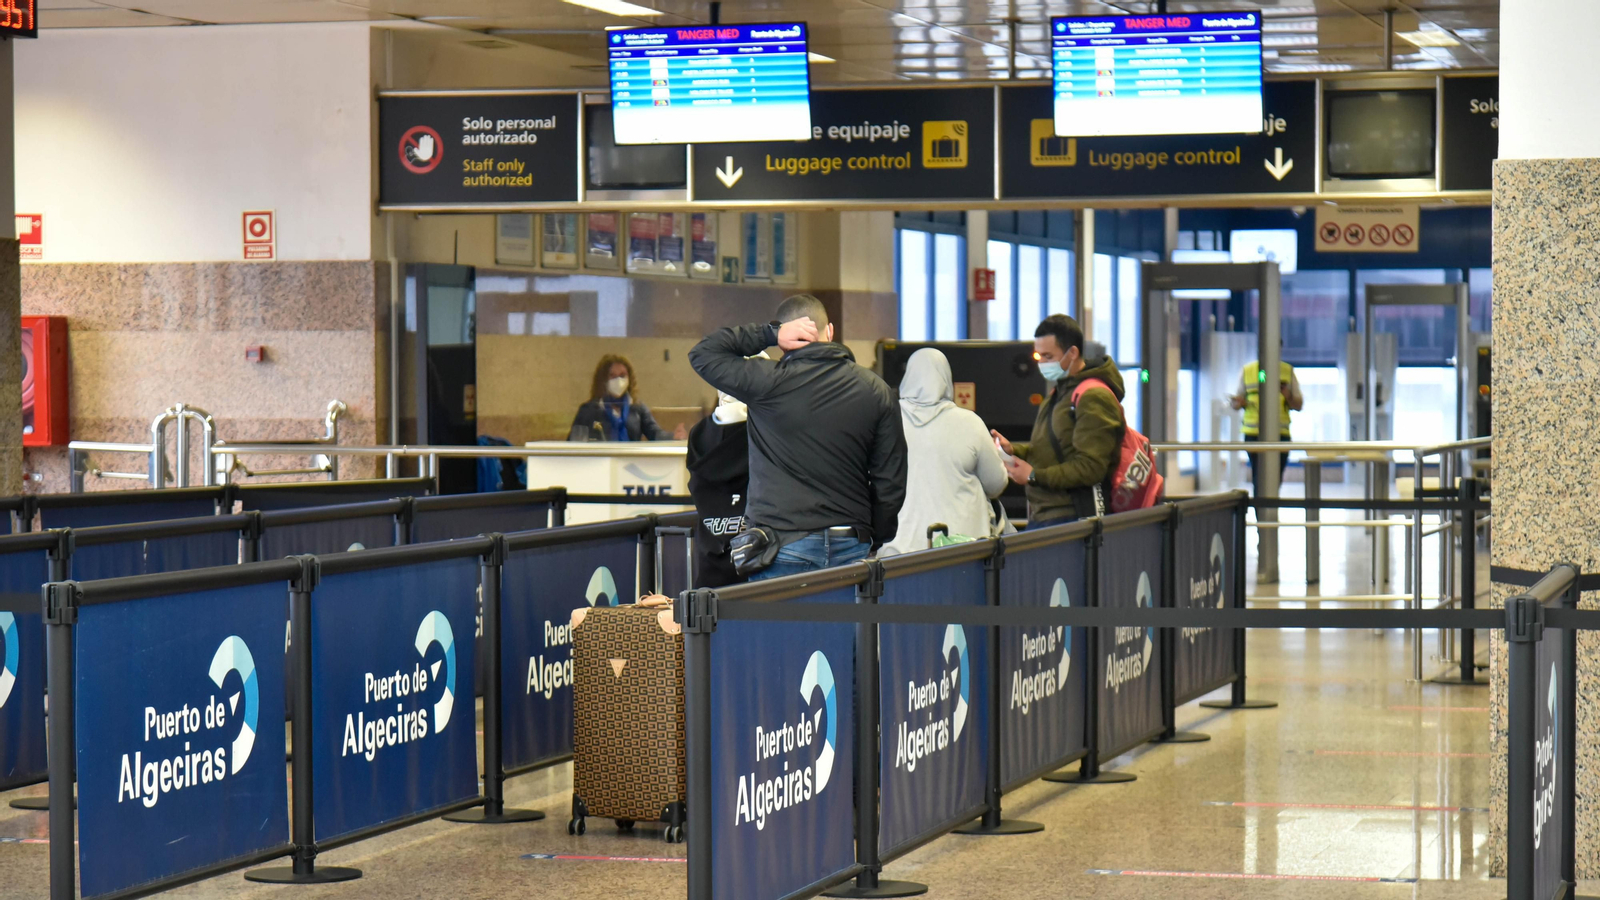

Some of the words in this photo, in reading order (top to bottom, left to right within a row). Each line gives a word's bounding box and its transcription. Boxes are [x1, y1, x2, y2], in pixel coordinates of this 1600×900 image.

[676, 29, 715, 40] TANGER
[717, 28, 740, 39] MED
[1124, 18, 1165, 29] TANGER
[1166, 17, 1191, 28] MED
[462, 116, 493, 131] Solo
[496, 115, 556, 133] personal
[462, 130, 537, 145] autorizado
[828, 120, 911, 143] equipaje
[463, 158, 494, 172] Staff
[497, 158, 525, 174] only
[463, 172, 533, 187] authorized
[765, 153, 842, 176] Luggage
[847, 151, 911, 170] control
[1089, 149, 1169, 171] Luggage
[1174, 146, 1241, 165] control
[1022, 632, 1046, 661] Puerto
[1047, 625, 1056, 653] de
[365, 669, 410, 704] Puerto
[412, 662, 427, 693] de
[526, 648, 573, 699] Algeci
[908, 678, 937, 712] Puerto
[940, 669, 950, 701] de
[1010, 661, 1055, 715] Algeciras
[1105, 646, 1141, 694] Algeciras
[144, 703, 200, 742] Puerto
[205, 695, 225, 730] de
[342, 703, 428, 762] Algeciras
[756, 721, 794, 762] Puerto
[796, 712, 812, 748] de
[895, 711, 949, 772] Algeciras
[118, 741, 226, 808] Algeciras
[735, 761, 812, 831] Algeciras
